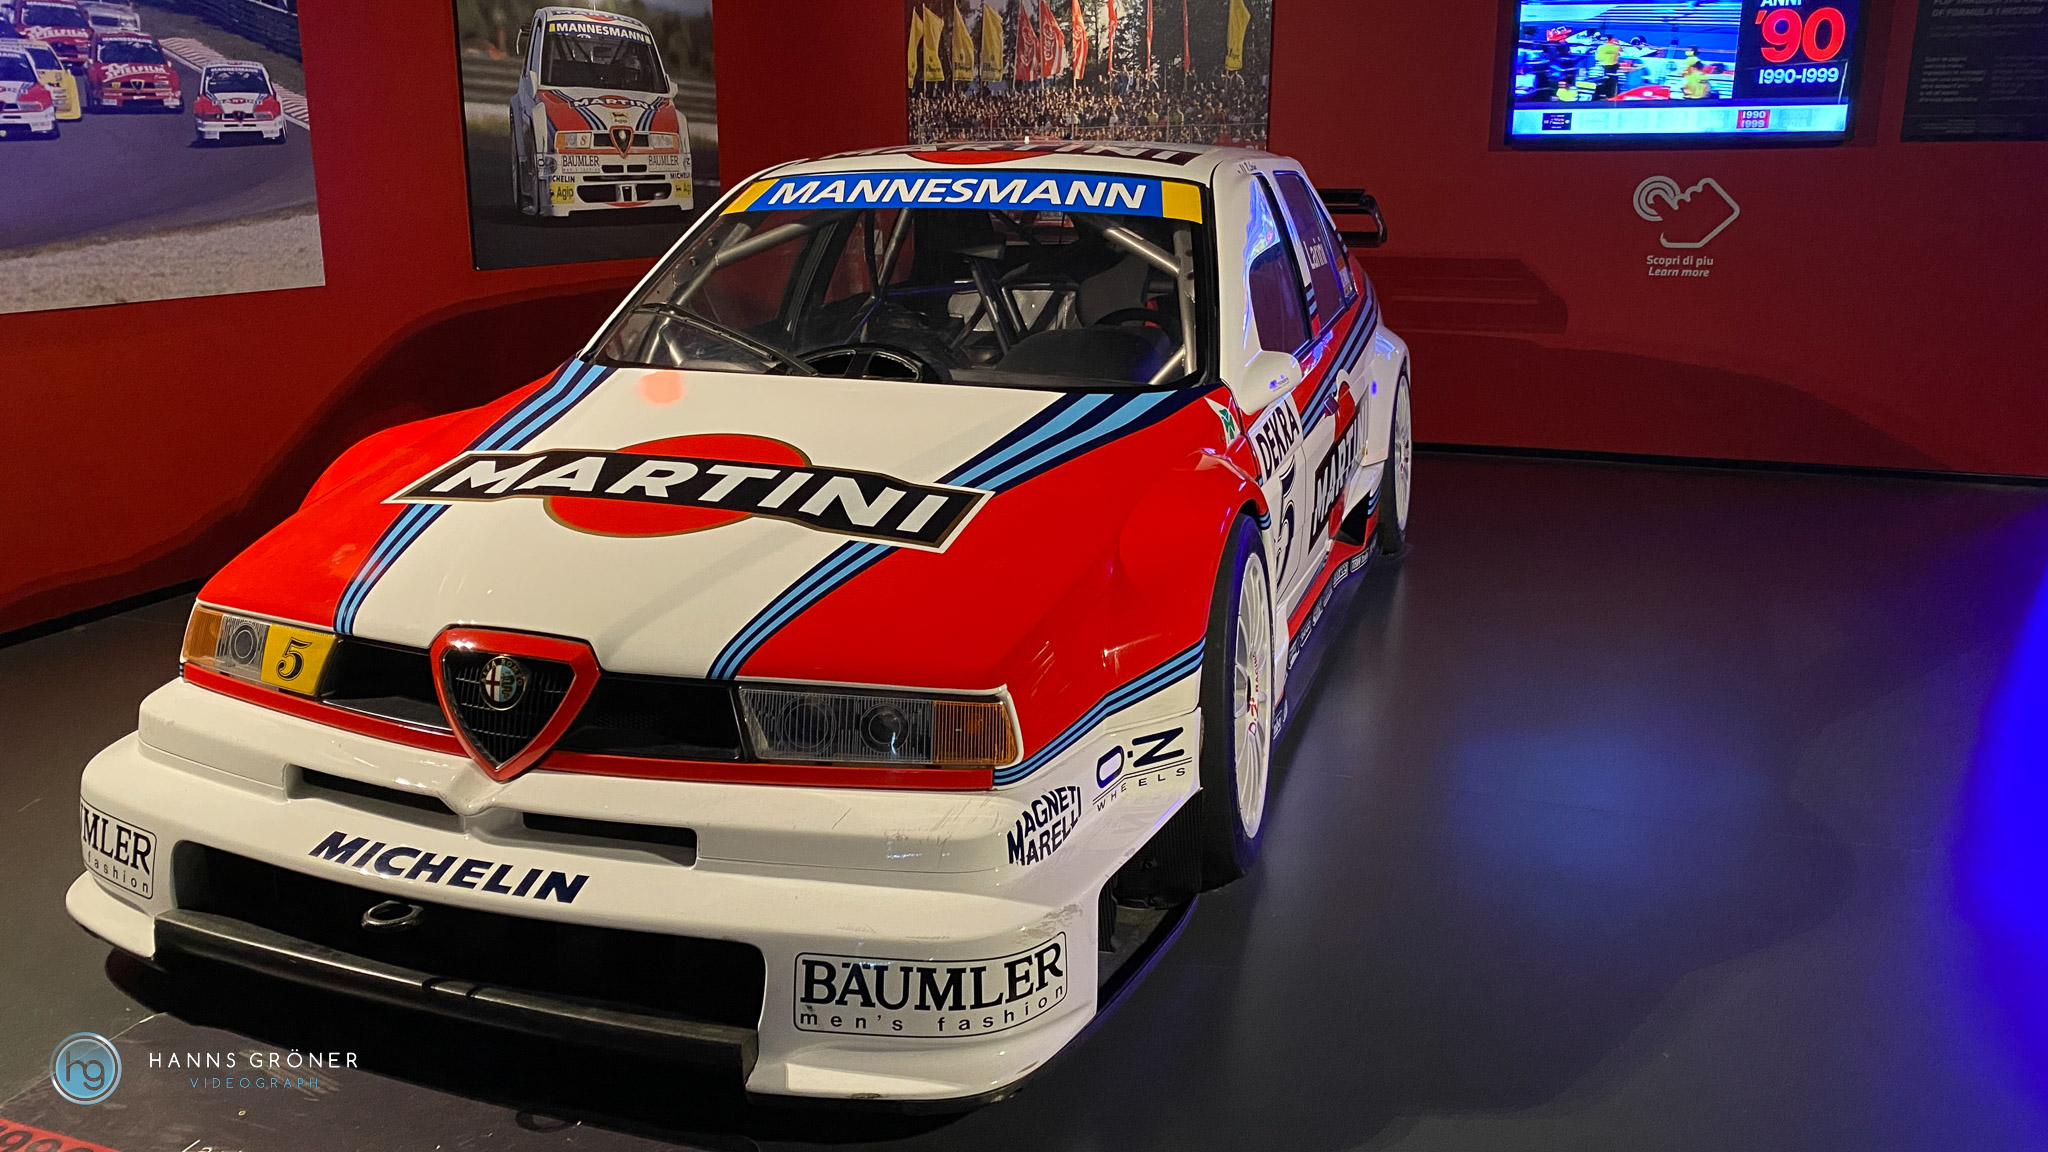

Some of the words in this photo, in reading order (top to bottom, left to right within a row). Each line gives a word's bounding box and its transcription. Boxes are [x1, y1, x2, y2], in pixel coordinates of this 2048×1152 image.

[556, 23, 645, 43] MANNESMANN
[1758, 68, 1840, 85] 1990-1999
[1741, 120, 1765, 128] 1999
[1742, 110, 1766, 119] 1990
[556, 186, 574, 201] Agip
[768, 178, 1146, 209] MANNESMANN
[1646, 255, 1680, 267] Scopri
[1682, 256, 1694, 265] di
[1696, 256, 1714, 267] piu
[1648, 266, 1679, 277] Learn
[1681, 269, 1710, 277] more
[1255, 400, 1300, 480] DEKRA
[429, 456, 950, 533] MARTINI
[276, 637, 312, 681] 5
[1096, 767, 1187, 812] WHEELS
[308, 830, 590, 904] MICHELIN
[937, 985, 1064, 1032] fashion
